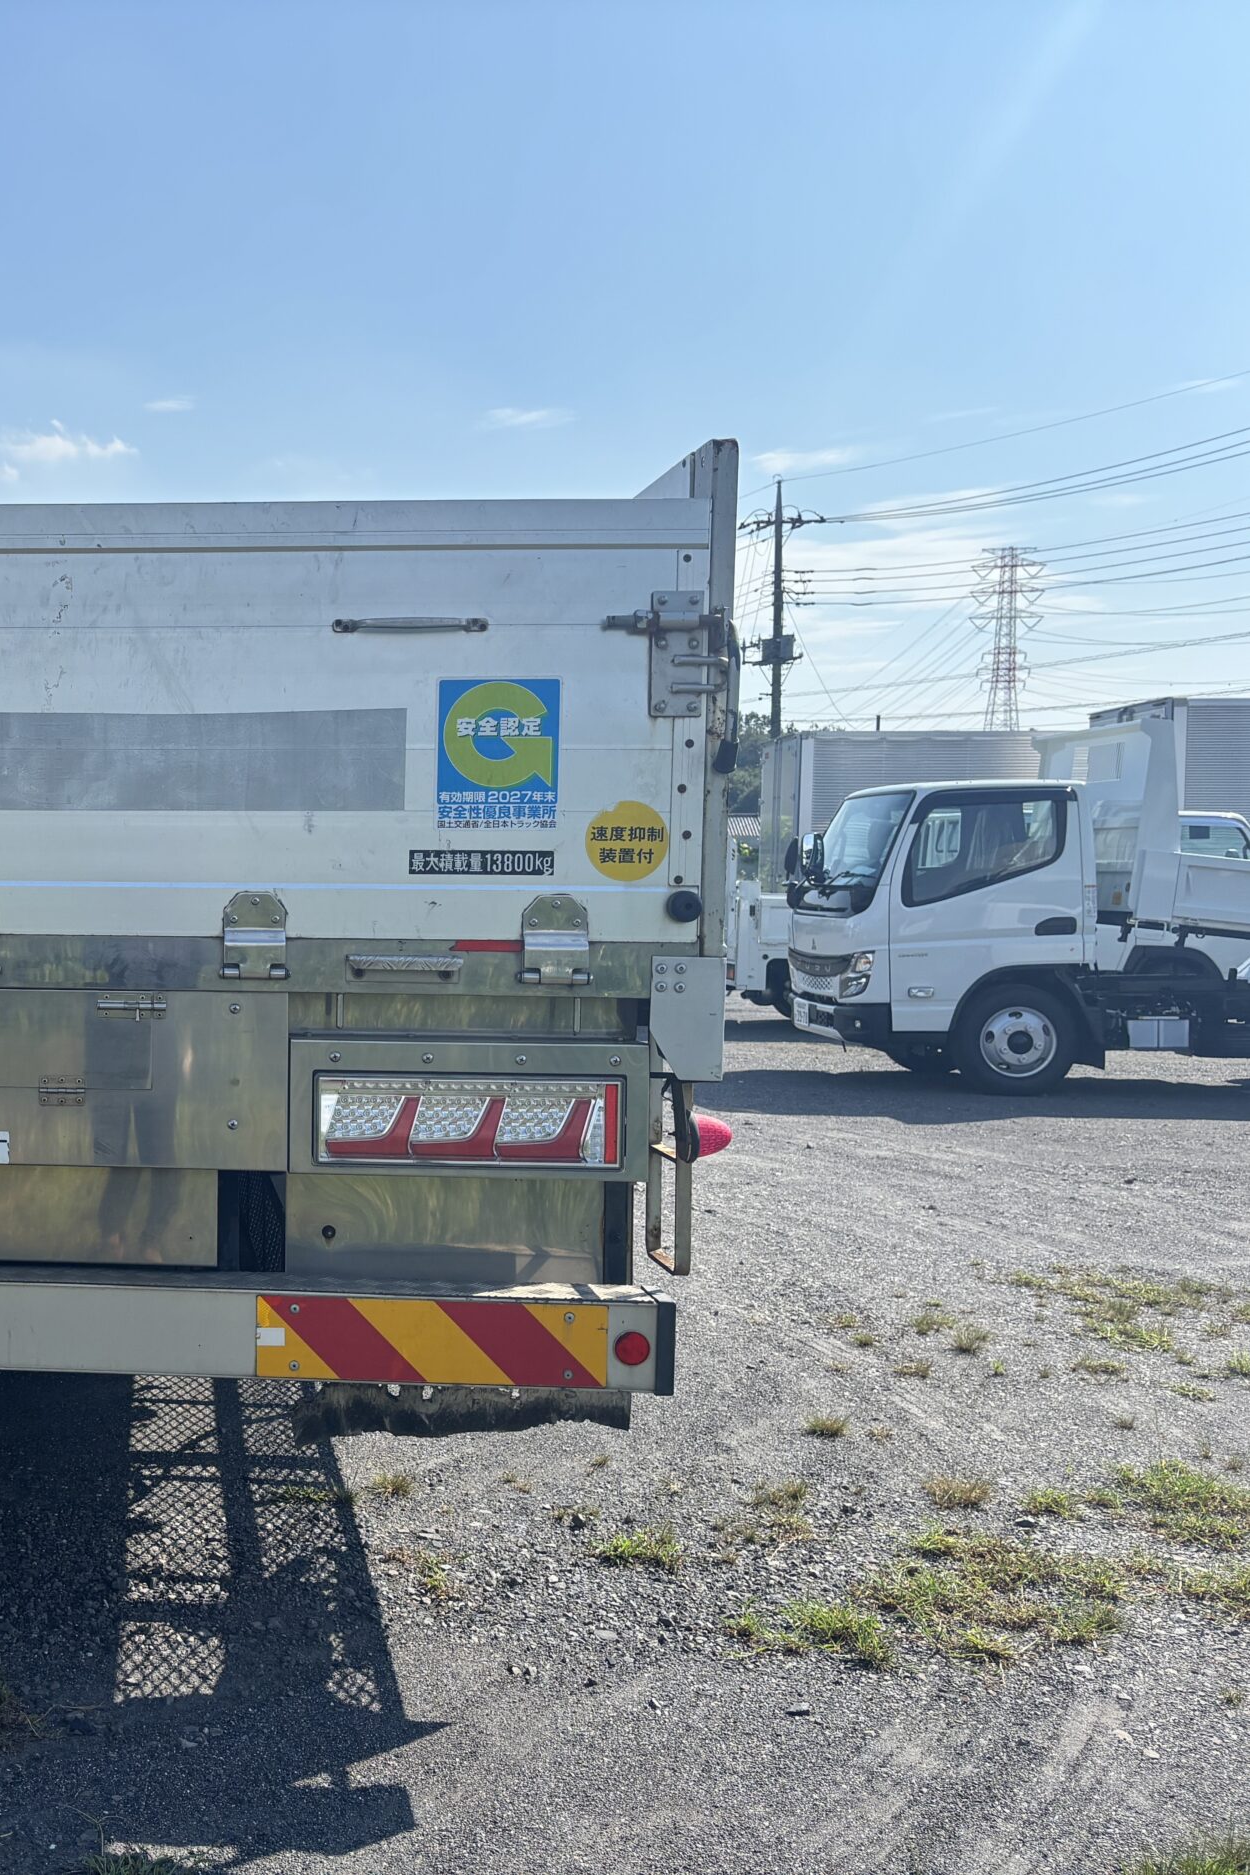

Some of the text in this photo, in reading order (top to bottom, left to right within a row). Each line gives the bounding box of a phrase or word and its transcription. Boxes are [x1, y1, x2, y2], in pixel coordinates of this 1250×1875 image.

[456, 717, 542, 738] 安全認定
[438, 805, 557, 820] 安全性優良事業所
[437, 820, 557, 829] 国土交通省/全日本トラック協会
[590, 826, 664, 842] 速度抑制
[599, 848, 654, 864] 装置付
